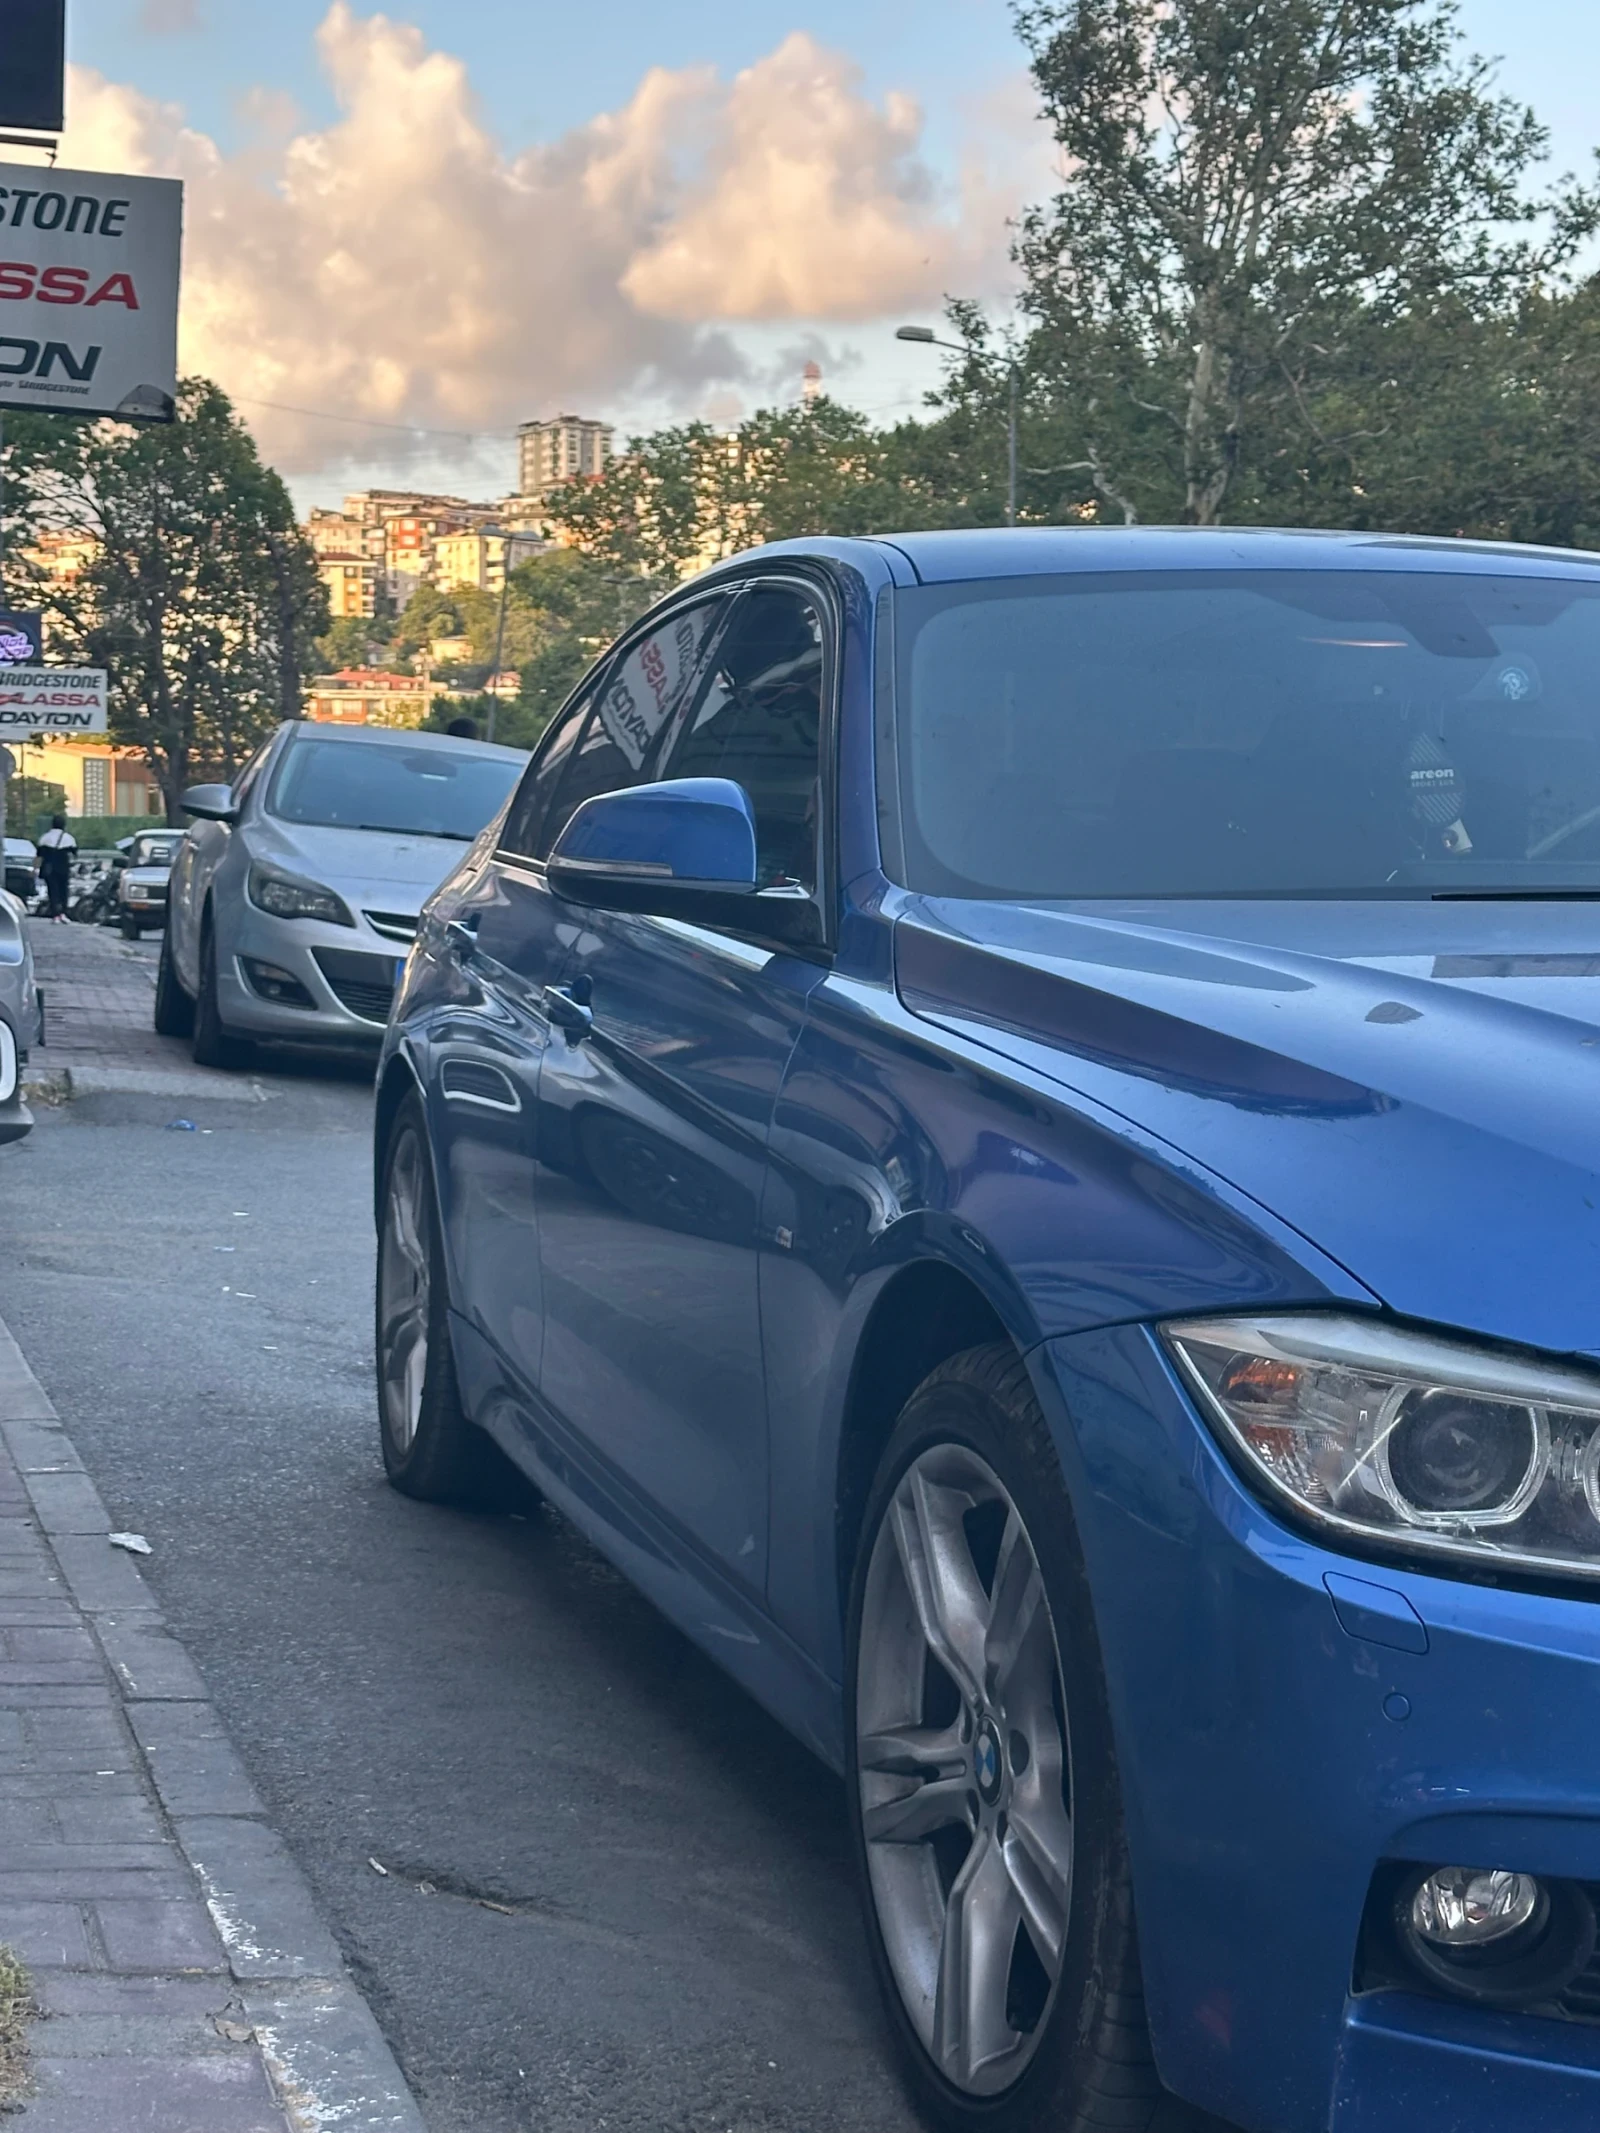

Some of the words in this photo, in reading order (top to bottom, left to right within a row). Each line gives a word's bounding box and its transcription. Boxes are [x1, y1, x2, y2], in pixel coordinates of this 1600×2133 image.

[17, 691, 101, 707] LASSA
[0, 711, 93, 725] DAYTON
[1410, 768, 1454, 780] areon
